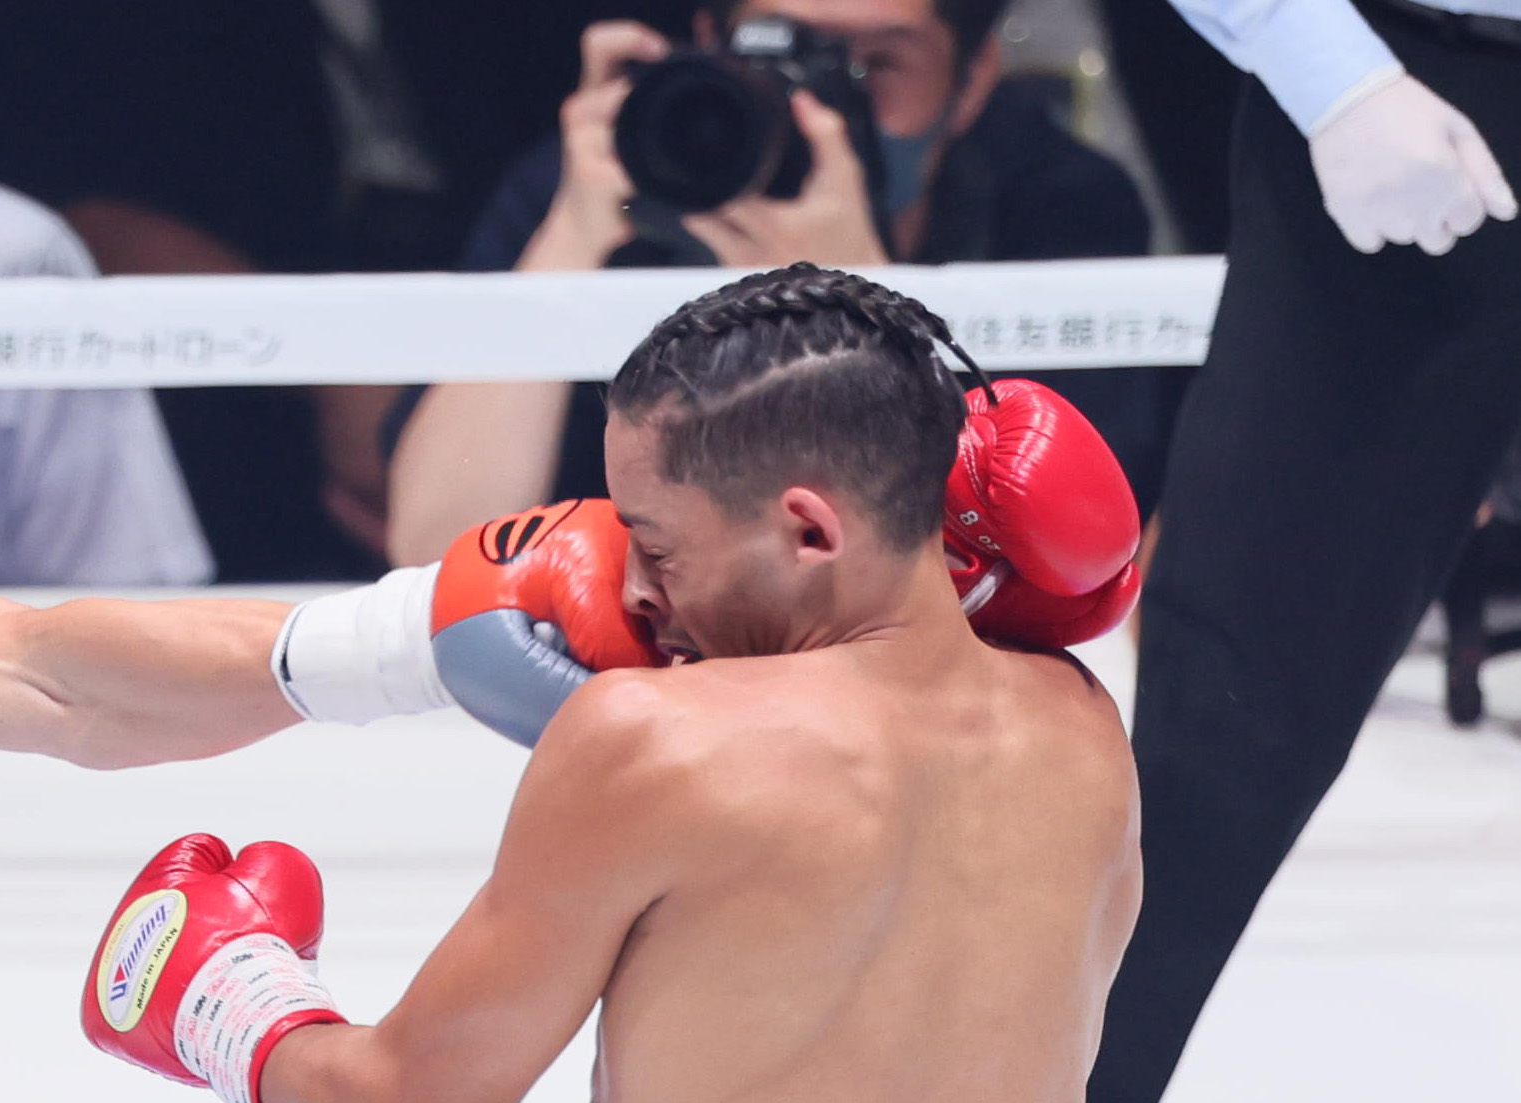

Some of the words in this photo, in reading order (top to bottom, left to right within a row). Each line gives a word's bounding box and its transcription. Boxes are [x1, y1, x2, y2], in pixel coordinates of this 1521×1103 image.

[959, 510, 978, 525] 8
[110, 904, 167, 1001] Winning
[136, 978, 149, 1009] Made
[145, 963, 155, 975] in
[153, 927, 178, 959] JAPAN
